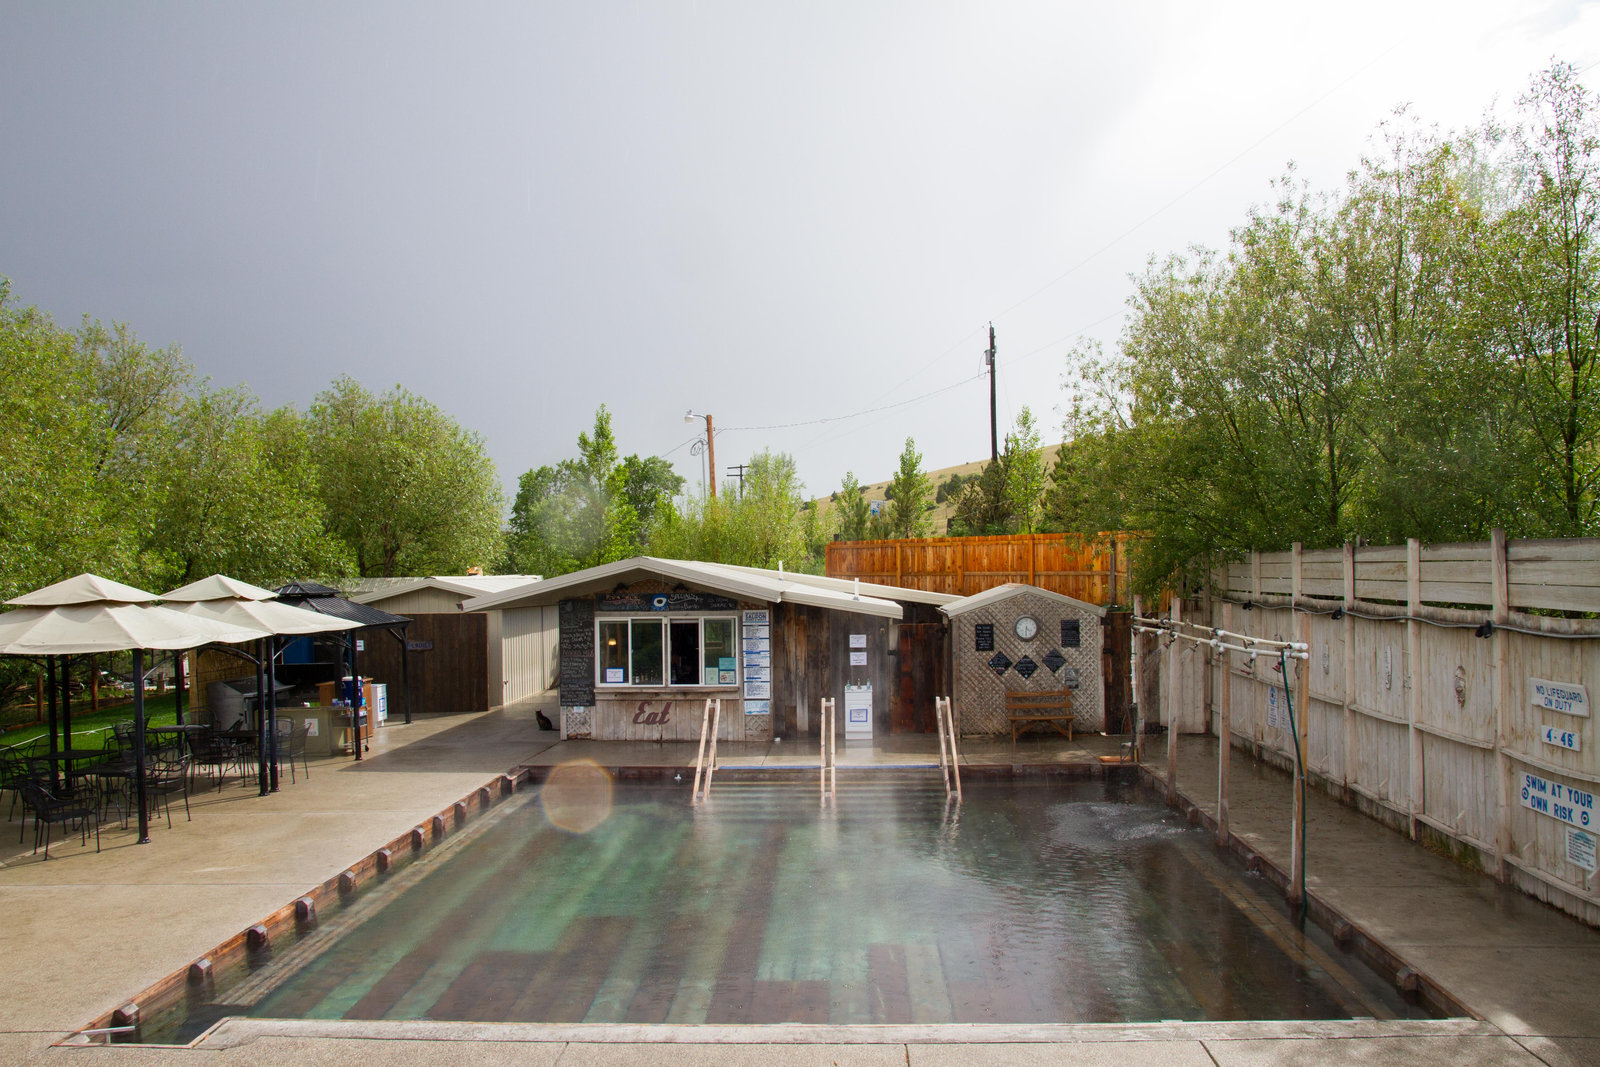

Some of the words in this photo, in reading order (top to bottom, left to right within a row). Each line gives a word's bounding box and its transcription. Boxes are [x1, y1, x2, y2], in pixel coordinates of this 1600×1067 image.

[1535, 685, 1545, 695] NO
[1546, 687, 1582, 703] LIFEGUARD
[1544, 696, 1553, 707] ON
[1555, 699, 1572, 712] DUTY
[632, 701, 672, 725] Eat
[1525, 775, 1547, 794] SWIM
[1551, 783, 1562, 798] AT
[1567, 788, 1593, 809] YOUR
[1530, 795, 1548, 813] OWN
[1553, 803, 1574, 823] RISK
